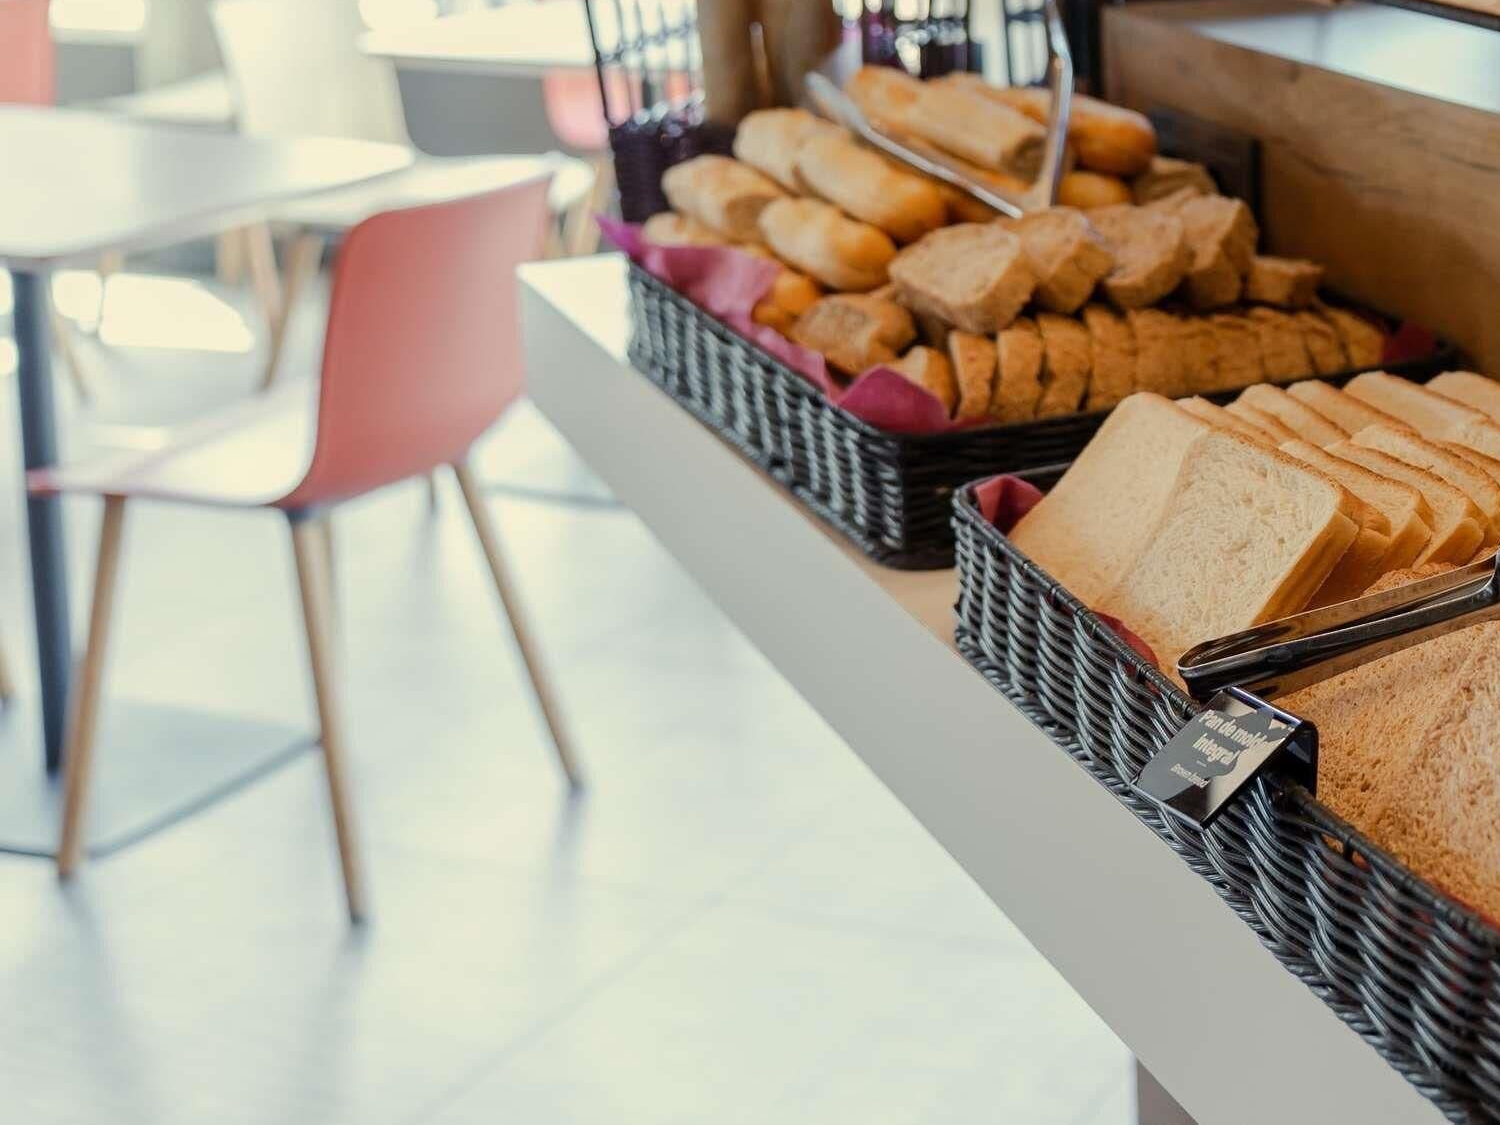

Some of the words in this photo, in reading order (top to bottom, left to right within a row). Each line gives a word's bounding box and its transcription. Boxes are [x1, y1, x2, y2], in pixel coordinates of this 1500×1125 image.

[1198, 709, 1222, 731] Pan
[1217, 718, 1238, 737] de
[1192, 732, 1241, 766] Integral
